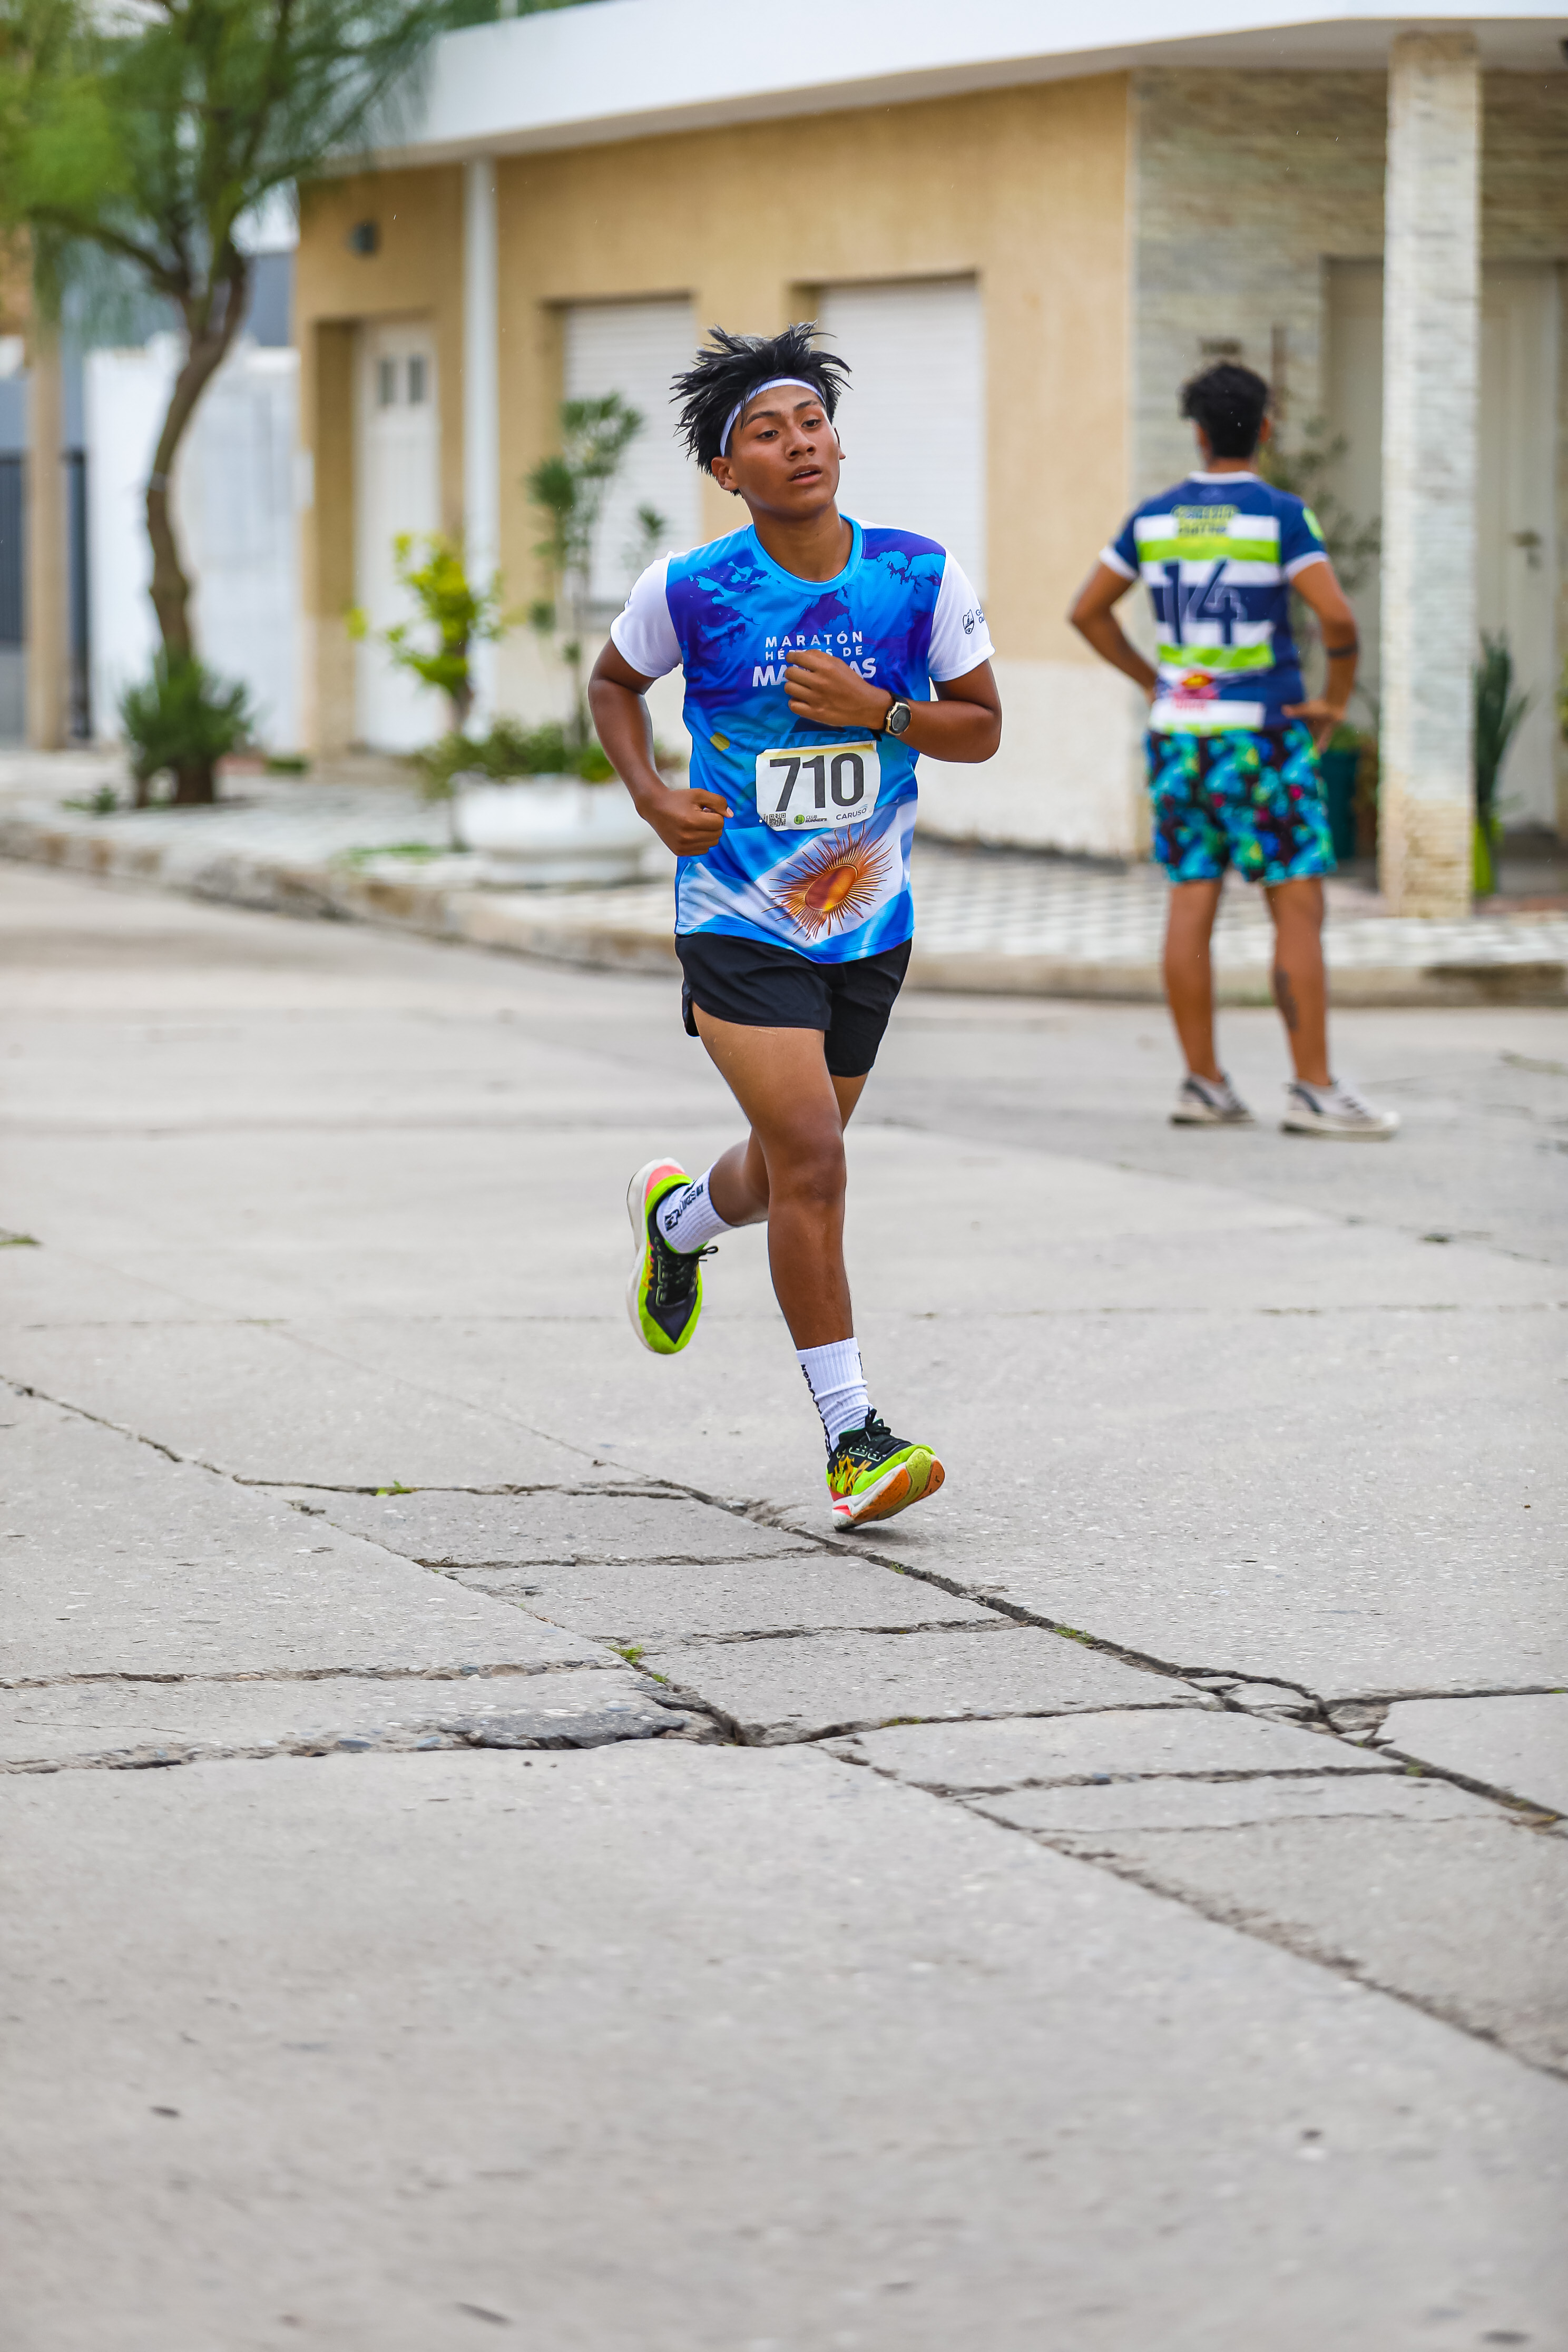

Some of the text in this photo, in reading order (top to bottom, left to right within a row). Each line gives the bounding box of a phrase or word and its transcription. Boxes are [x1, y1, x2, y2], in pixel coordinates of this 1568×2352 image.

[1163, 561, 1240, 646] 14
[766, 631, 863, 648] MARATÓN
[766, 645, 863, 660] HÉS DE
[752, 658, 876, 687] MAAS
[769, 752, 864, 812] 710
[836, 807, 867, 820] CARUSO
